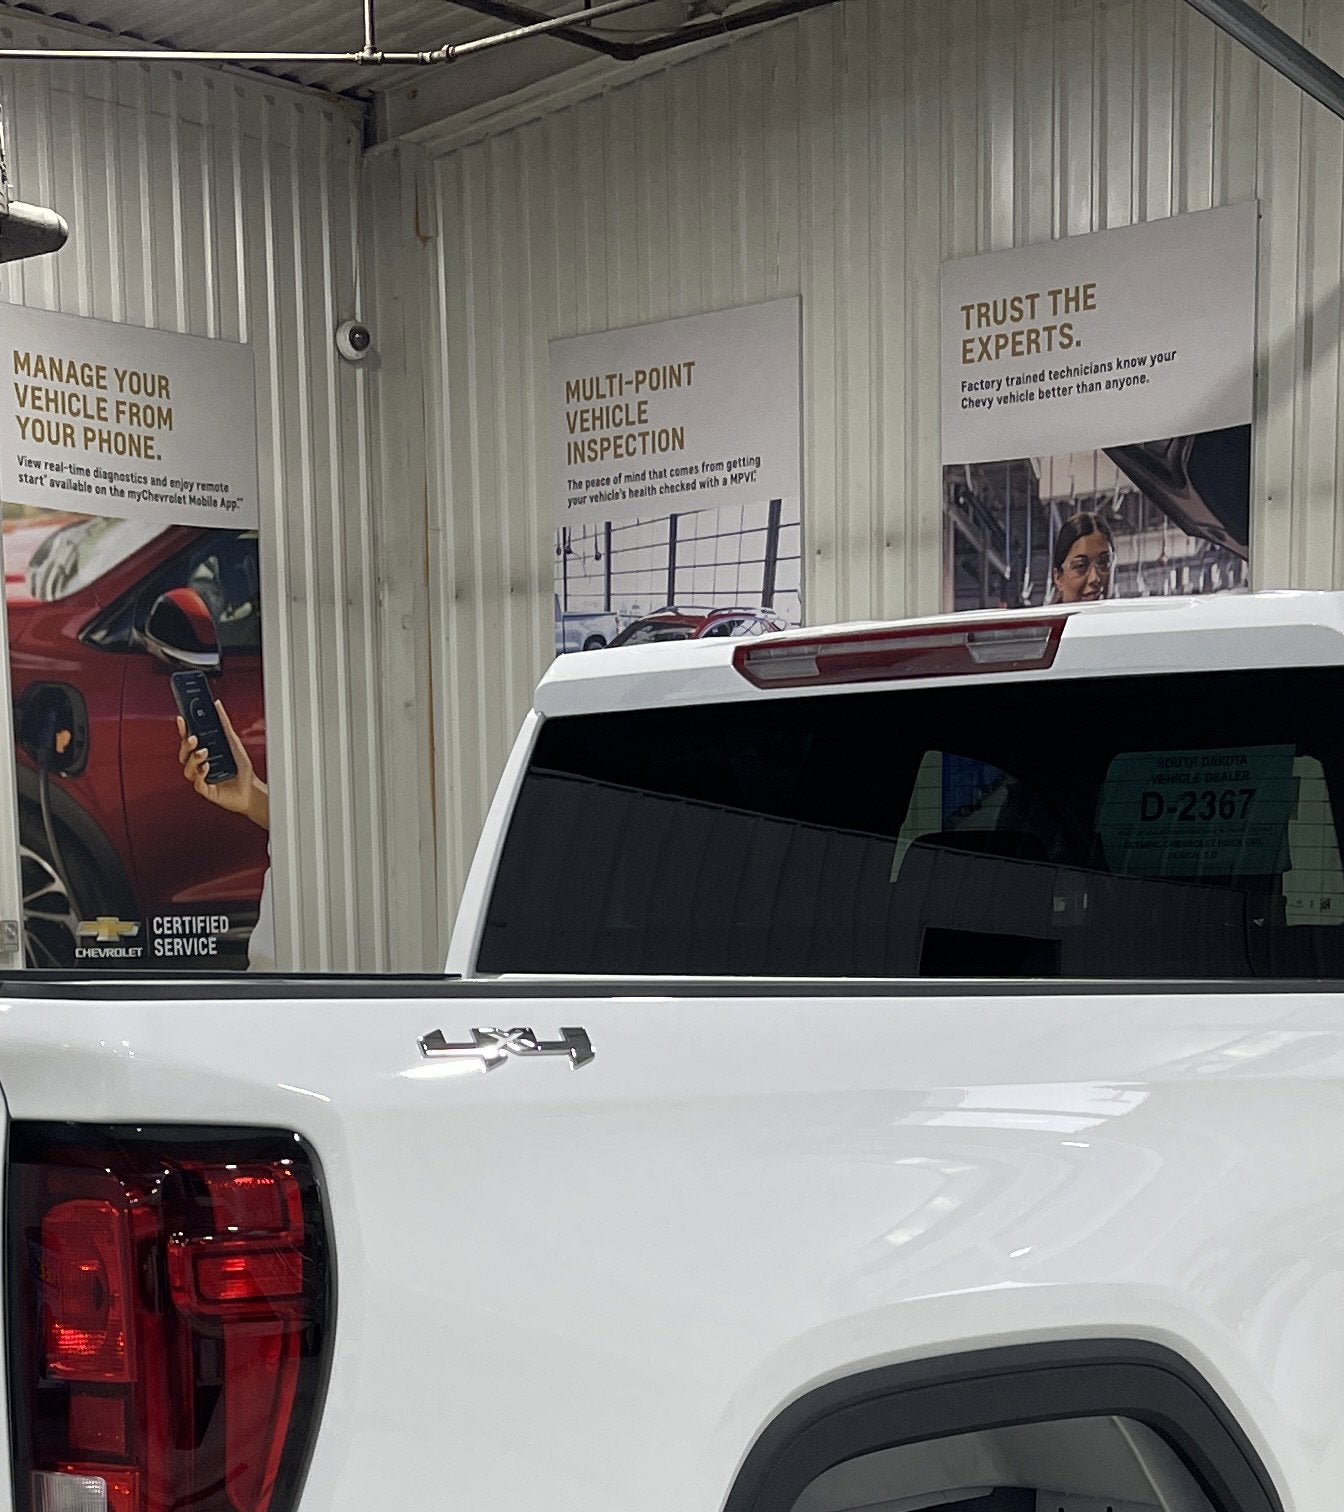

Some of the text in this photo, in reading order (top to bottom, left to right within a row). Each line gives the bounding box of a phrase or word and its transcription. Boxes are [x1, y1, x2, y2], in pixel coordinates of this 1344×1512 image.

[960, 282, 1097, 331] TRUST THE
[961, 322, 1082, 365] EXPERTS.
[13, 350, 170, 400] MANAGE YOUR
[565, 361, 696, 404] MULTI-POINT
[961, 350, 1177, 393] Factory trained technicians know your
[13, 382, 173, 431] VEHICLE FROM
[961, 374, 1150, 410] Chevy vehicle better than anyone.
[566, 400, 649, 434] VEHICLE
[15, 414, 162, 461] YOUR PHONE.
[567, 426, 685, 466] INSPECTION
[16, 455, 229, 493] View real-time diagnostics and enjoy remote
[567, 456, 761, 491] The peace of mind that comes from getting
[49, 477, 92, 494] available
[95, 486, 107, 496] on
[109, 485, 125, 498] the
[127, 489, 187, 505] myChevrolet
[189, 494, 218, 508] Mobile
[567, 496, 587, 509] your
[588, 488, 626, 503] vehicle's
[629, 485, 657, 498] health
[659, 479, 697, 495] checked
[699, 476, 719, 489] with
[722, 477, 728, 487] a
[1201, 755, 1248, 767] DAKOTA
[1204, 770, 1250, 782] DEALER
[1140, 788, 1256, 822] D-2367
[153, 915, 229, 935] CERTIFIED
[75, 947, 143, 959] CHEVROLET
[154, 937, 218, 957] SERVICE
